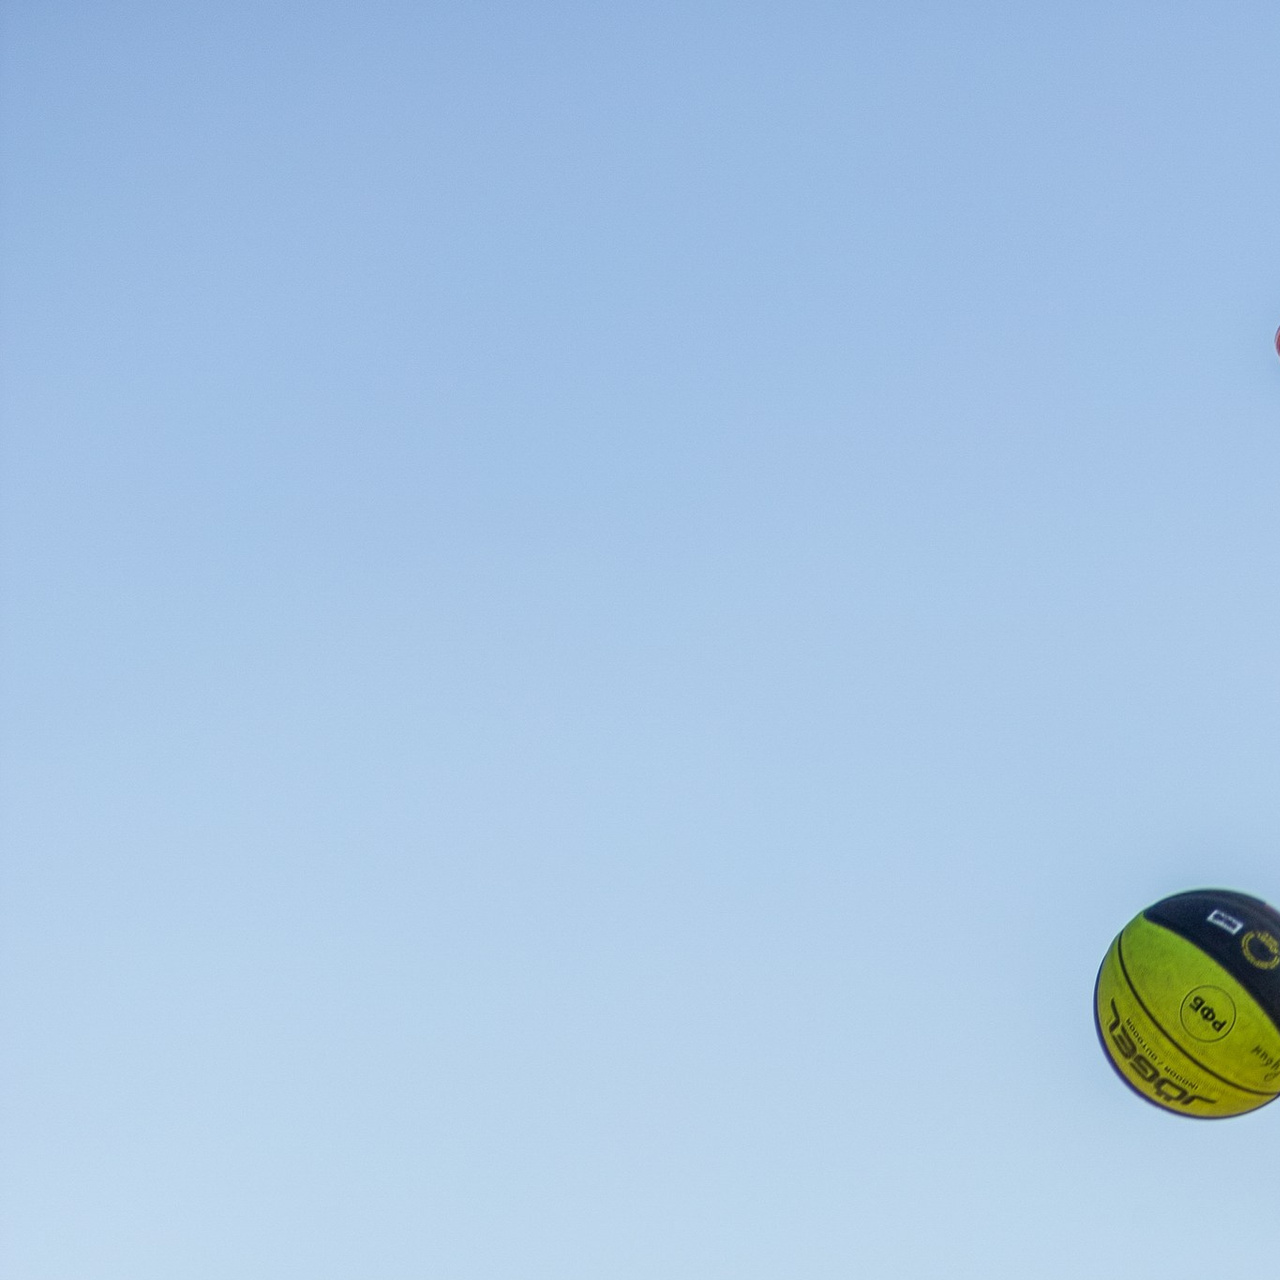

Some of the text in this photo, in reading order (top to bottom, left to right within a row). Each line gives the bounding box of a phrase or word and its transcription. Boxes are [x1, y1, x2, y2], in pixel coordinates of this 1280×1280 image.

[1188, 995, 1227, 1033] РФБ
[1125, 1018, 1158, 1061] OUTDOOR
[1163, 1066, 1199, 1091] INDOOR
